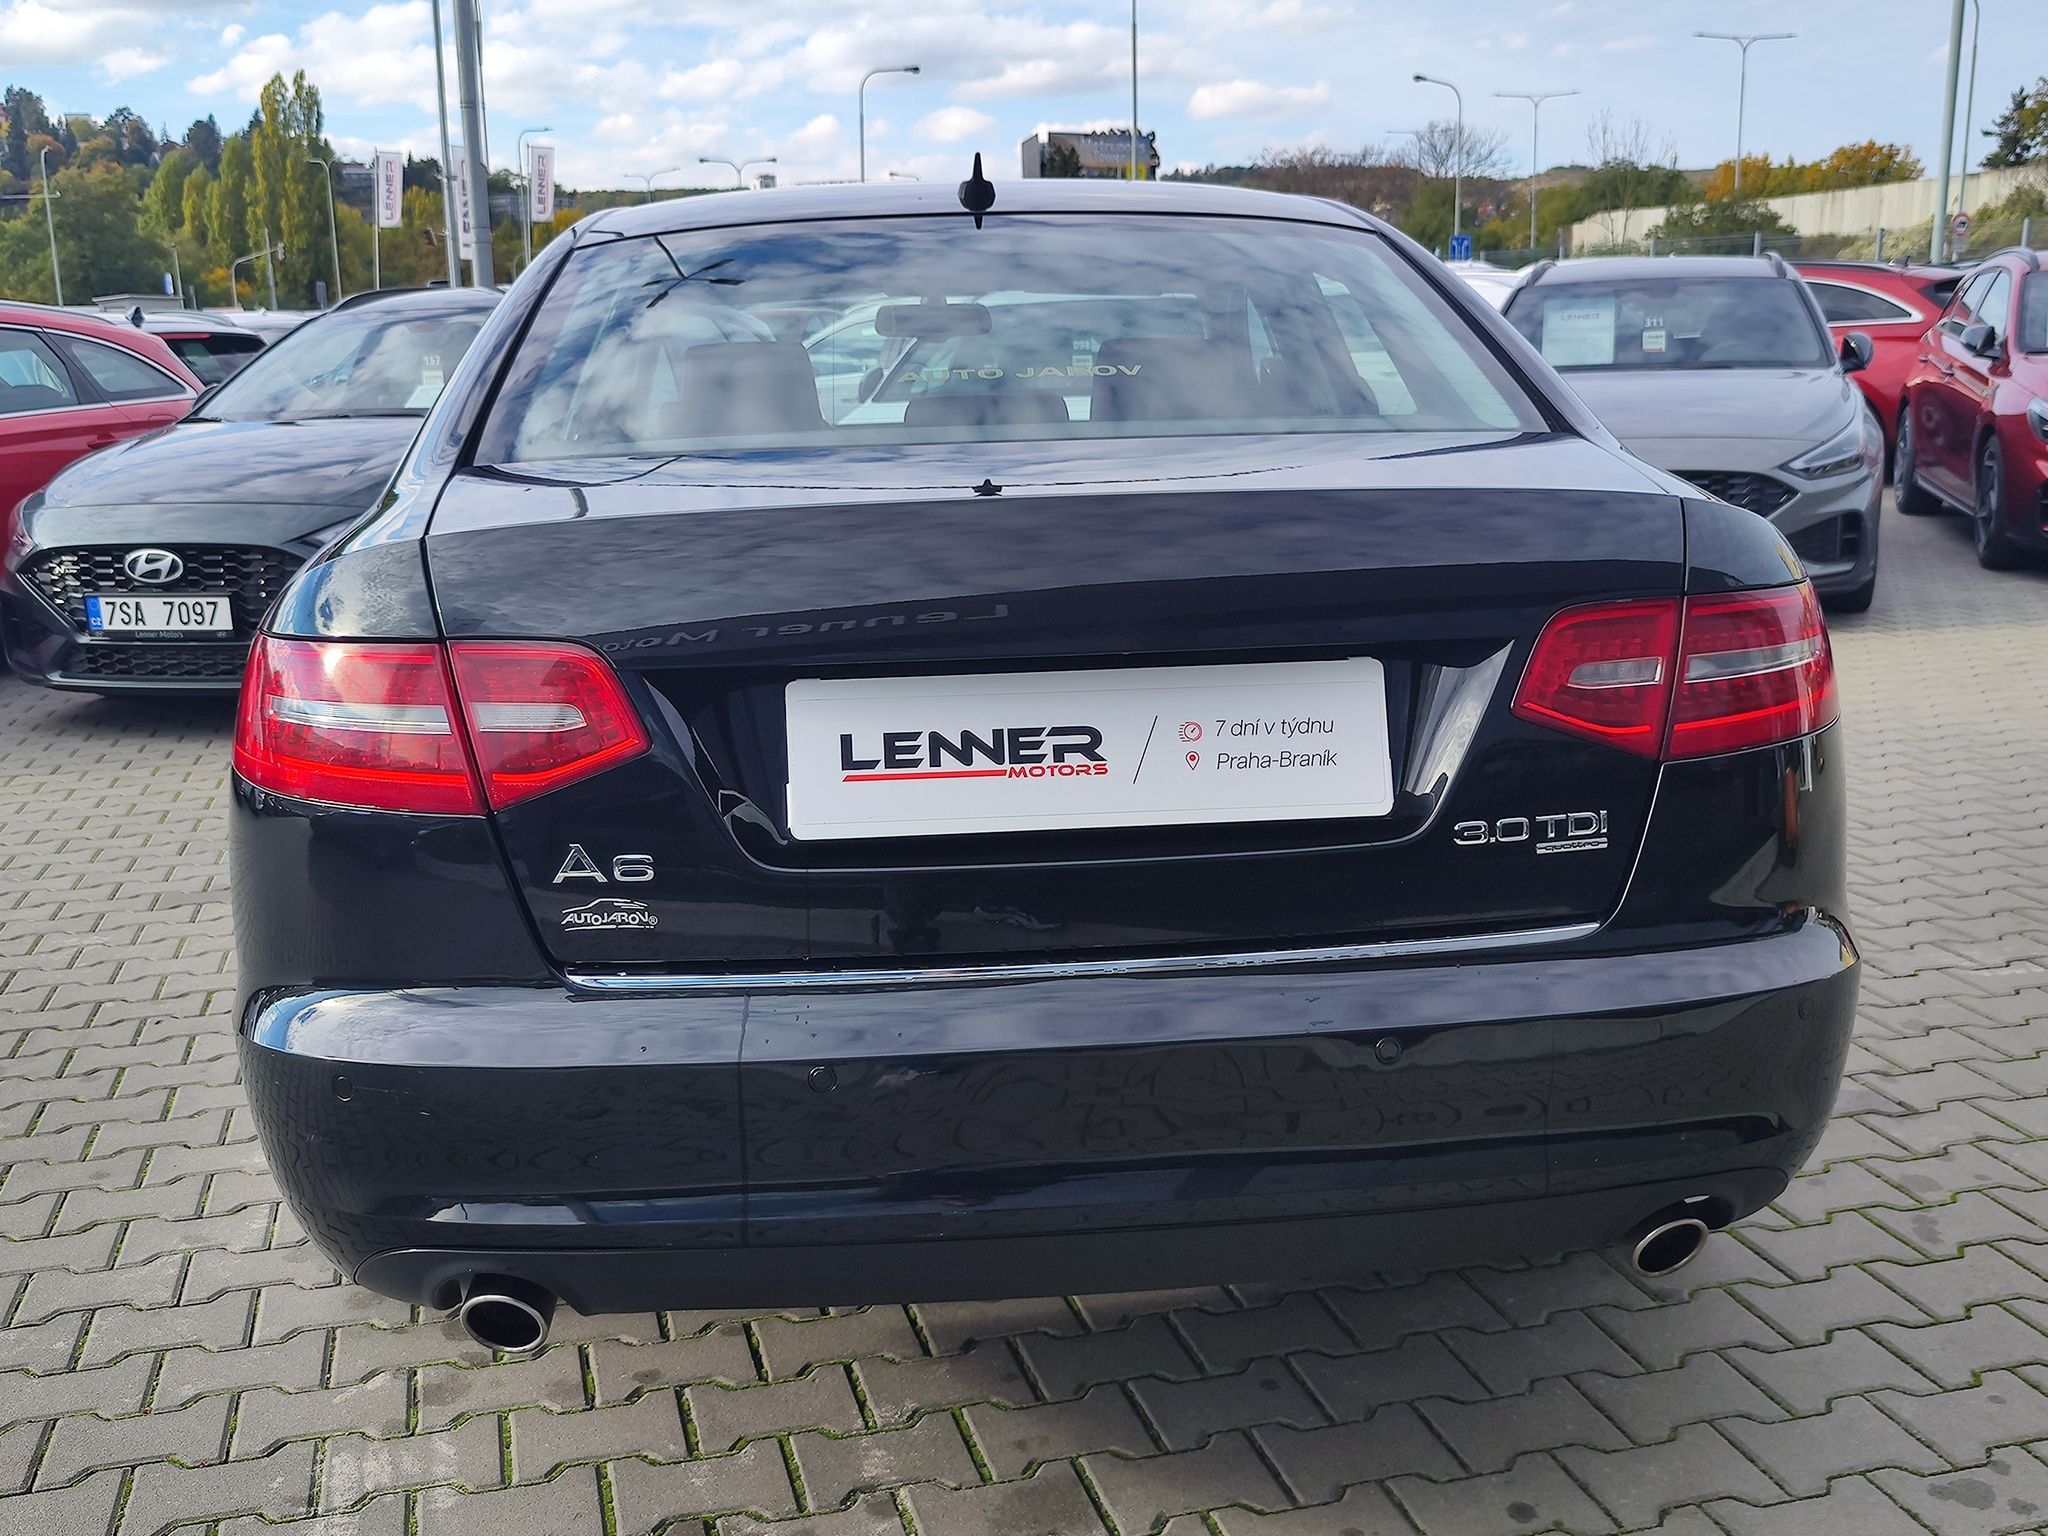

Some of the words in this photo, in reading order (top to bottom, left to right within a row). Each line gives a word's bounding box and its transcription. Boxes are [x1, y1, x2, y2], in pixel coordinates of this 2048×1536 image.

[386, 160, 395, 221] LENNER
[537, 155, 546, 215] LENNER
[897, 366, 1005, 384] AUTO
[105, 601, 147, 626] 7SA
[163, 601, 218, 626] 7097
[1215, 719, 1226, 737] 7
[1231, 718, 1261, 737] dní
[1264, 722, 1276, 736] v
[1280, 717, 1335, 739] týdnu
[839, 725, 1107, 771] LENNER
[1217, 749, 1338, 770] Praha-Braník
[1007, 762, 1109, 779] MOTORS
[1454, 817, 1530, 846] 3.0
[1535, 810, 1608, 839] TDI
[552, 843, 655, 883] A6
